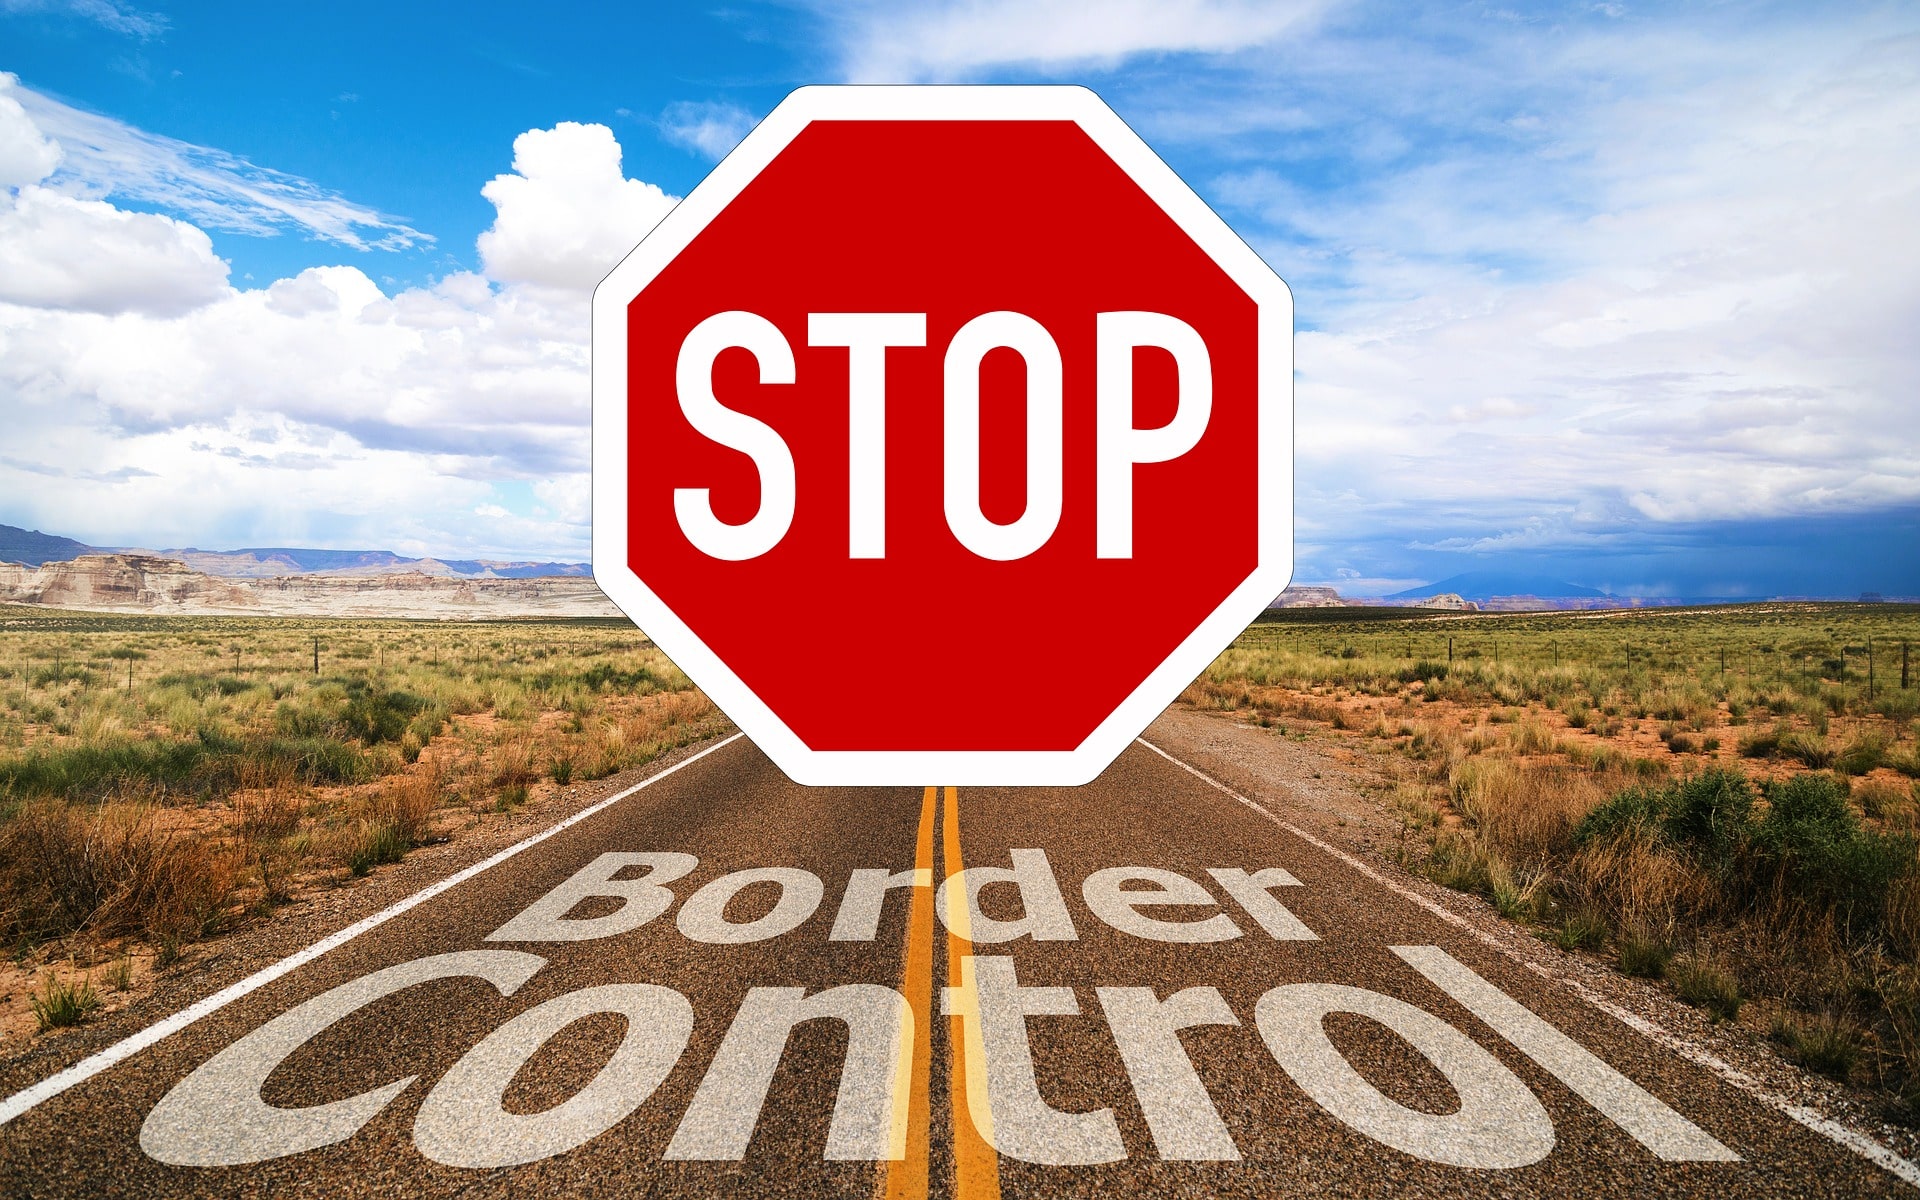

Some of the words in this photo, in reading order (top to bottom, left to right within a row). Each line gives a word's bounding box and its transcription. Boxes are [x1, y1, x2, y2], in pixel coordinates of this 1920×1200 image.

[673, 310, 1213, 561] STOP
[484, 848, 1322, 944] Border
[139, 945, 1746, 1170] Control
